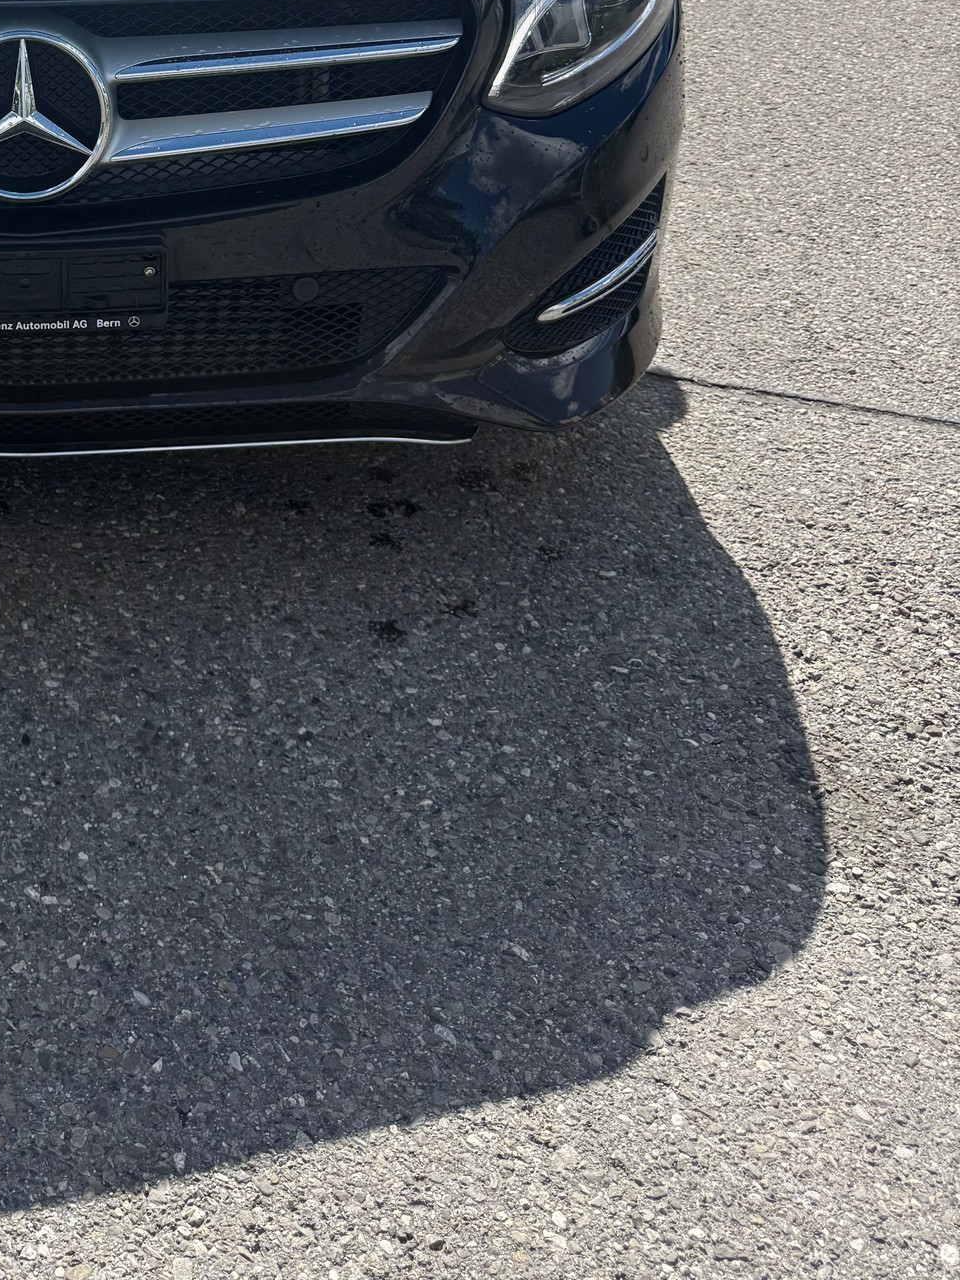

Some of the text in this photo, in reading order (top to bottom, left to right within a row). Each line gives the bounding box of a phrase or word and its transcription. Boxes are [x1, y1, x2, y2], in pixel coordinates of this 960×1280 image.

[16, 321, 70, 330] Automobil
[72, 320, 88, 329] AG
[96, 319, 121, 328] Bern
